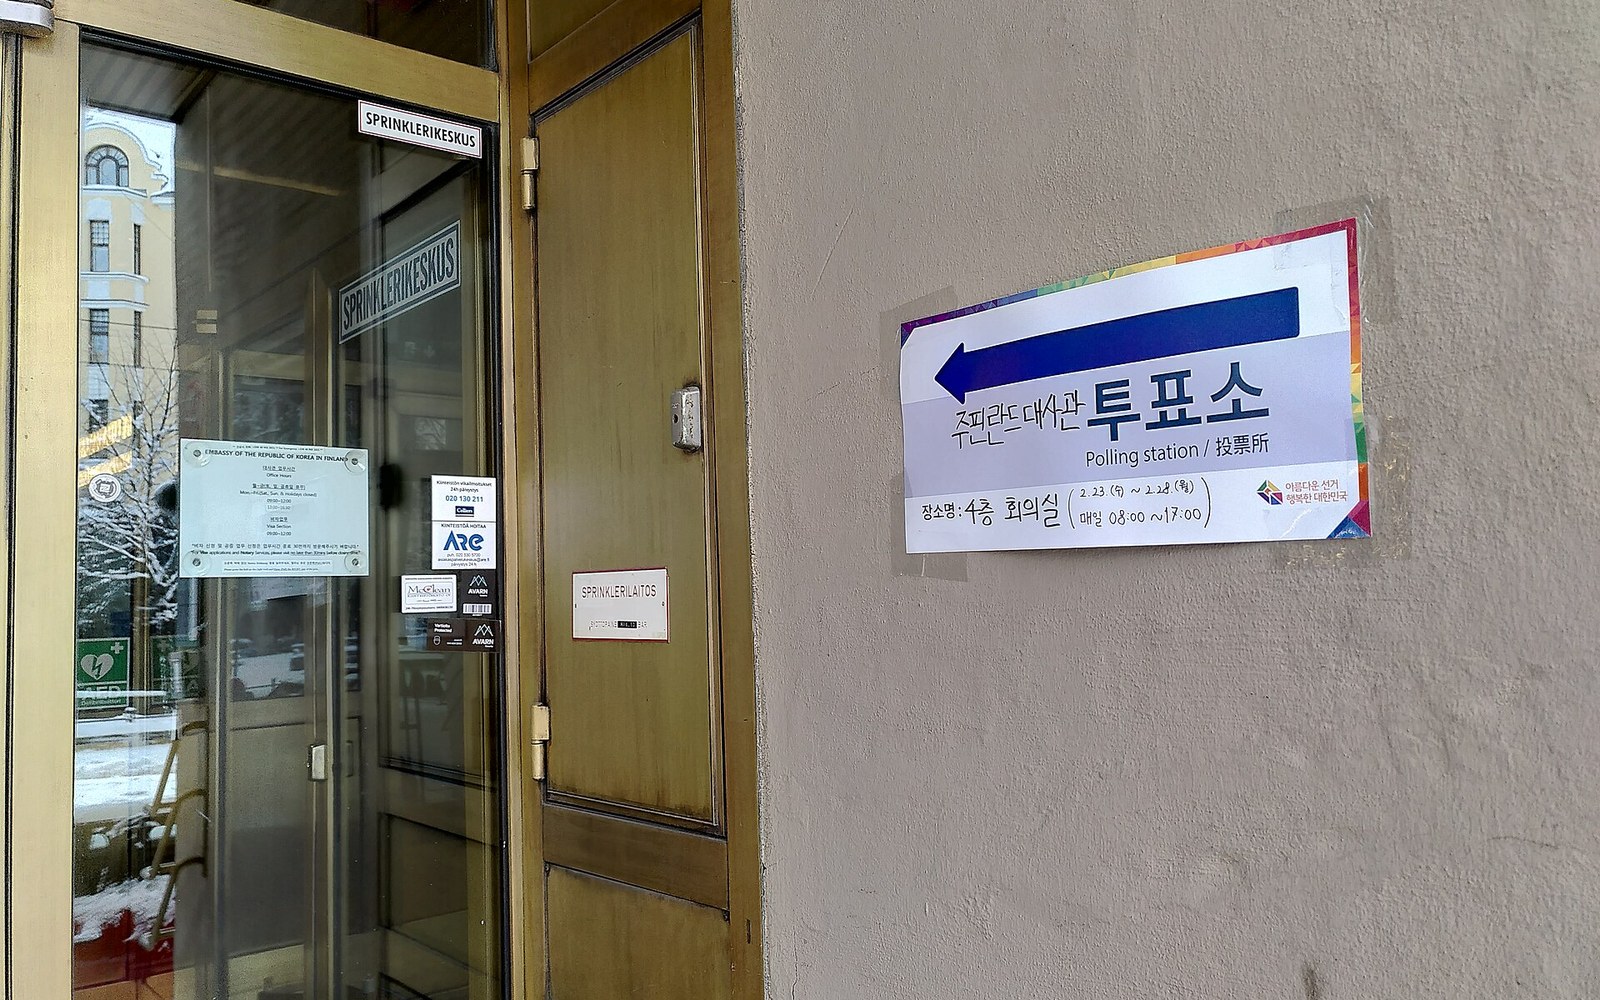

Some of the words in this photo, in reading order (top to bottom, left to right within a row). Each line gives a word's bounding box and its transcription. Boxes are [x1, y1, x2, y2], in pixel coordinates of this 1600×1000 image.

[365, 111, 477, 148] SPRINKLERIKESKUS
[343, 237, 455, 331] SPRINKLERIKESKUS
[1086, 361, 1270, 442] 투표소
[1086, 448, 1139, 468] Polling
[1143, 443, 1200, 463] station
[1215, 432, 1270, 457] 投票所
[1285, 480, 1319, 492] 아름다운
[1321, 479, 1338, 490] 선거
[445, 494, 458, 502] 020
[472, 495, 484, 503] 211
[1286, 493, 1312, 505] 행복한
[1313, 490, 1348, 503] 대한민국
[964, 498, 995, 526] 4층
[1004, 493, 1061, 528] 회의실
[1079, 510, 1102, 528] 매일
[1108, 509, 1145, 526] 08:00
[408, 584, 451, 595] McClean
[581, 584, 657, 599] SPRINKLERILAITOS
